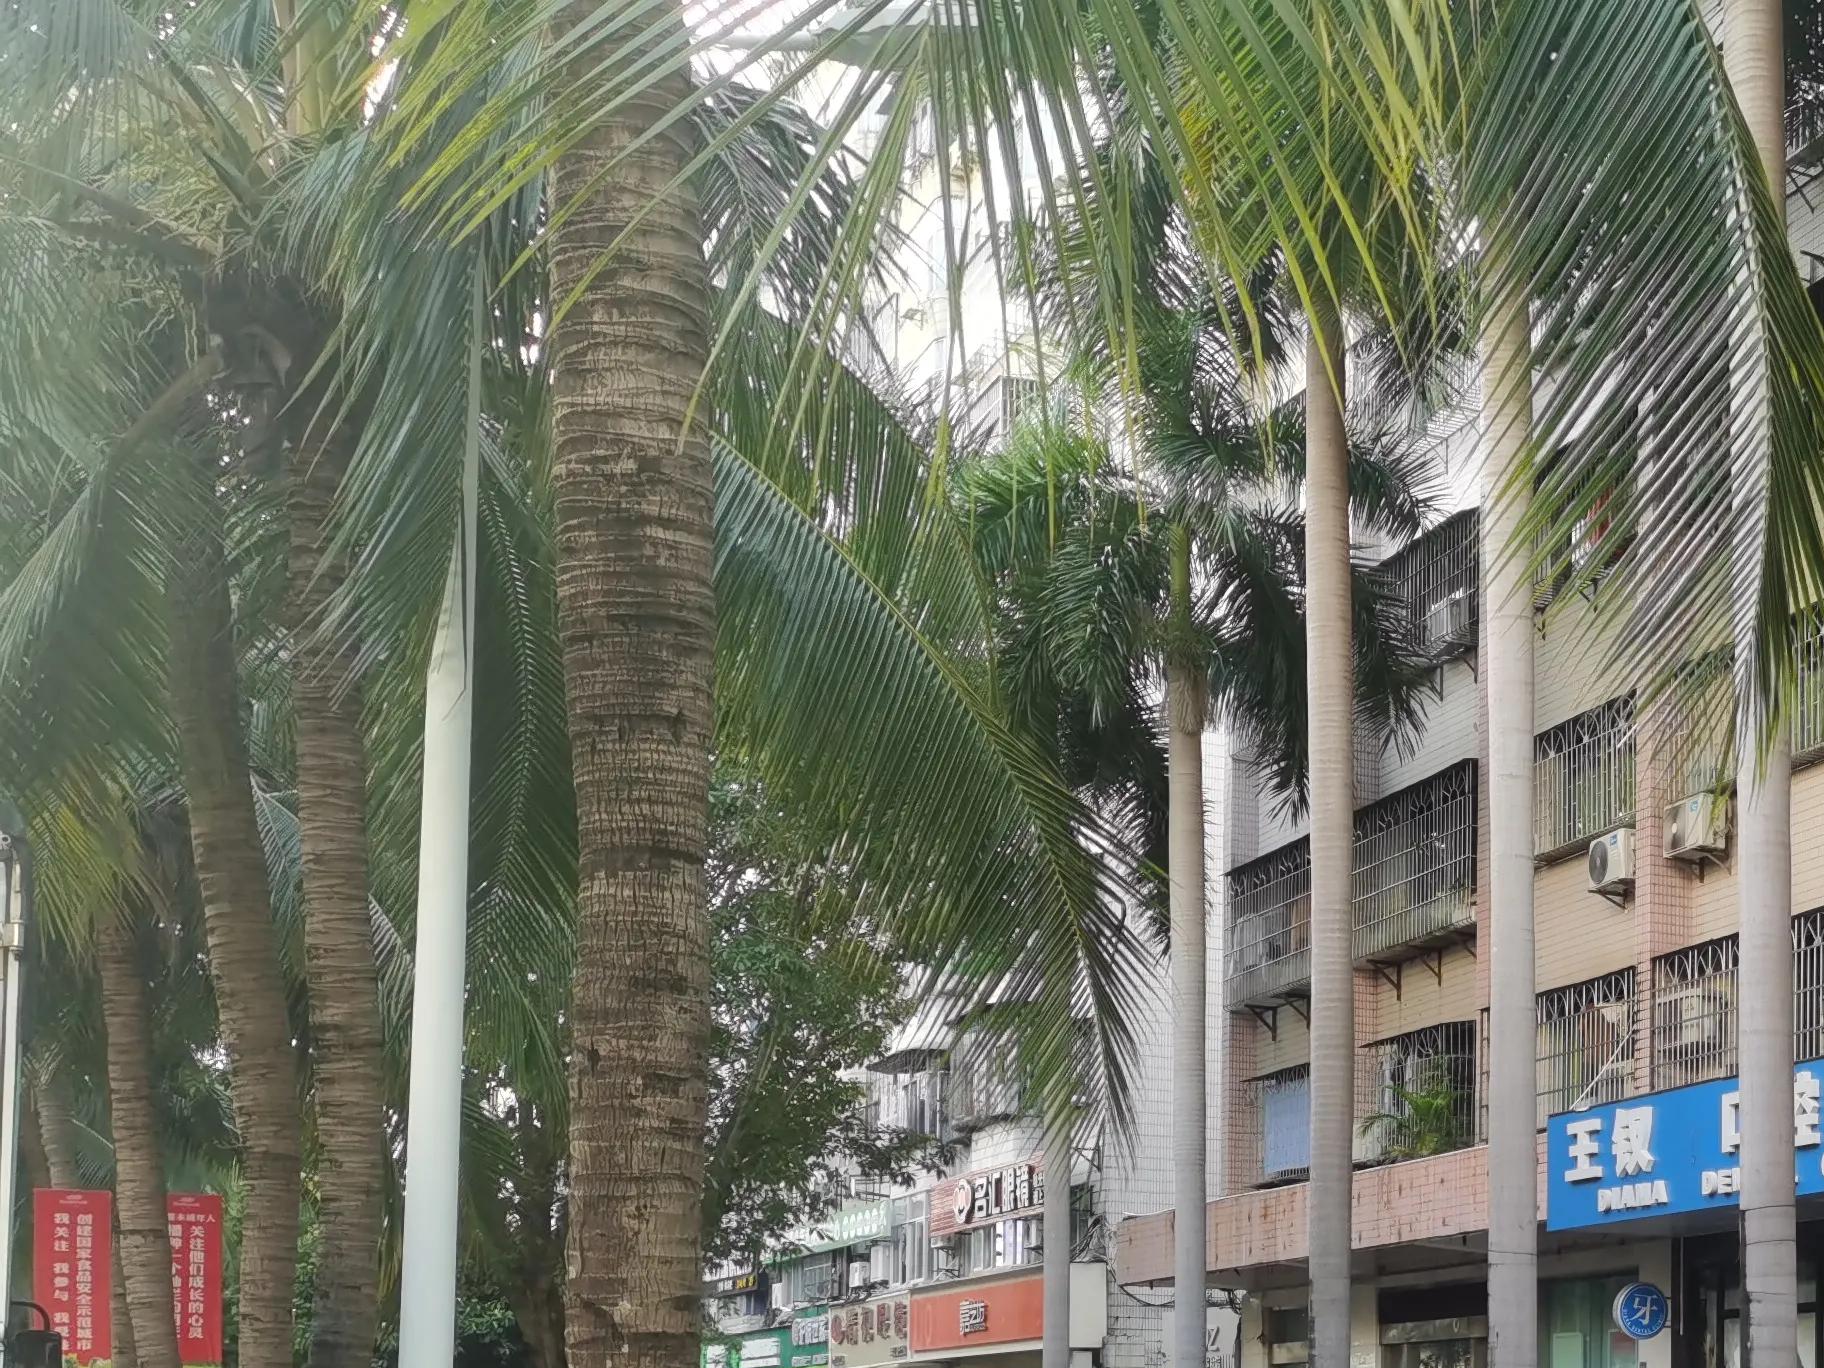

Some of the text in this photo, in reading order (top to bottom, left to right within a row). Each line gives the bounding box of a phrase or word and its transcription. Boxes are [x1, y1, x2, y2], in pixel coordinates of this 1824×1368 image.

[1597, 1180, 1668, 1213] DIANA
[76, 1213, 93, 1351] 创建国家食品安全示范城市
[1630, 1293, 1659, 1326] 牙
